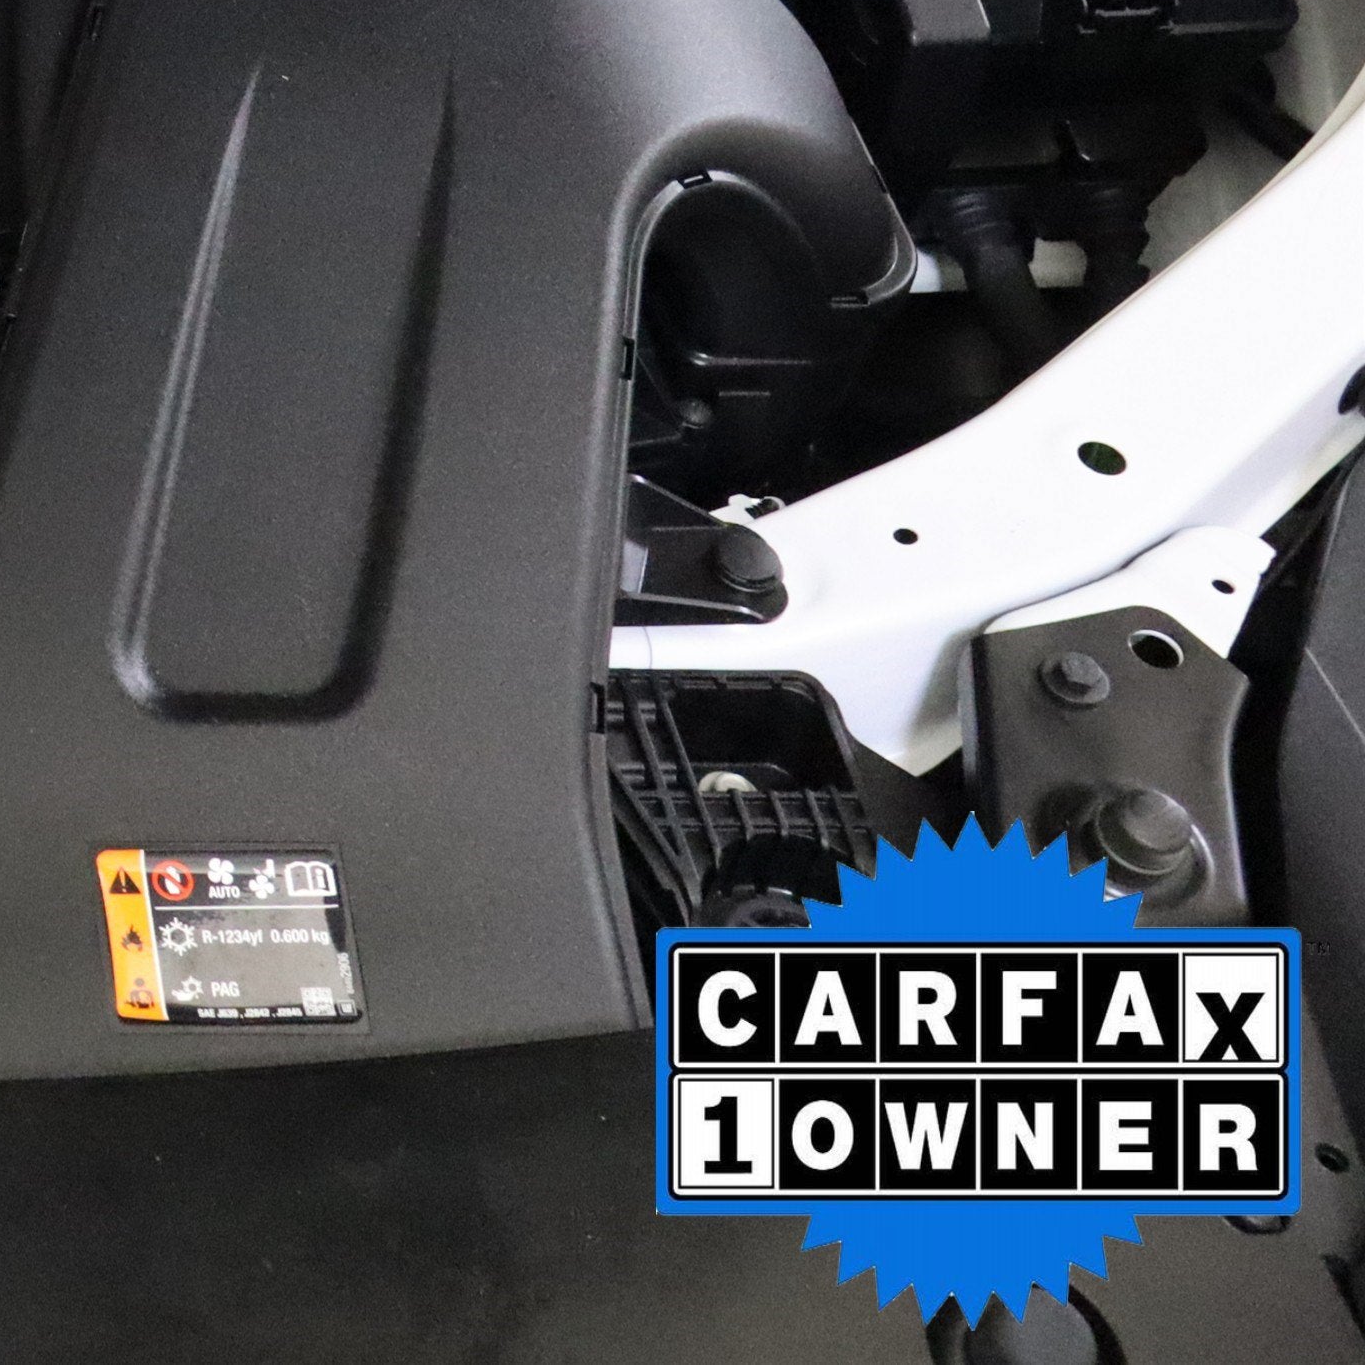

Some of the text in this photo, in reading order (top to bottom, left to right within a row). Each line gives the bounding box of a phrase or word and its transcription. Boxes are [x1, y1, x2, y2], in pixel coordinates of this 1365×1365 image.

[209, 885, 241, 899] AUTO
[202, 928, 330, 949] R-1234yf 0.600 kg
[211, 981, 241, 998] PAG
